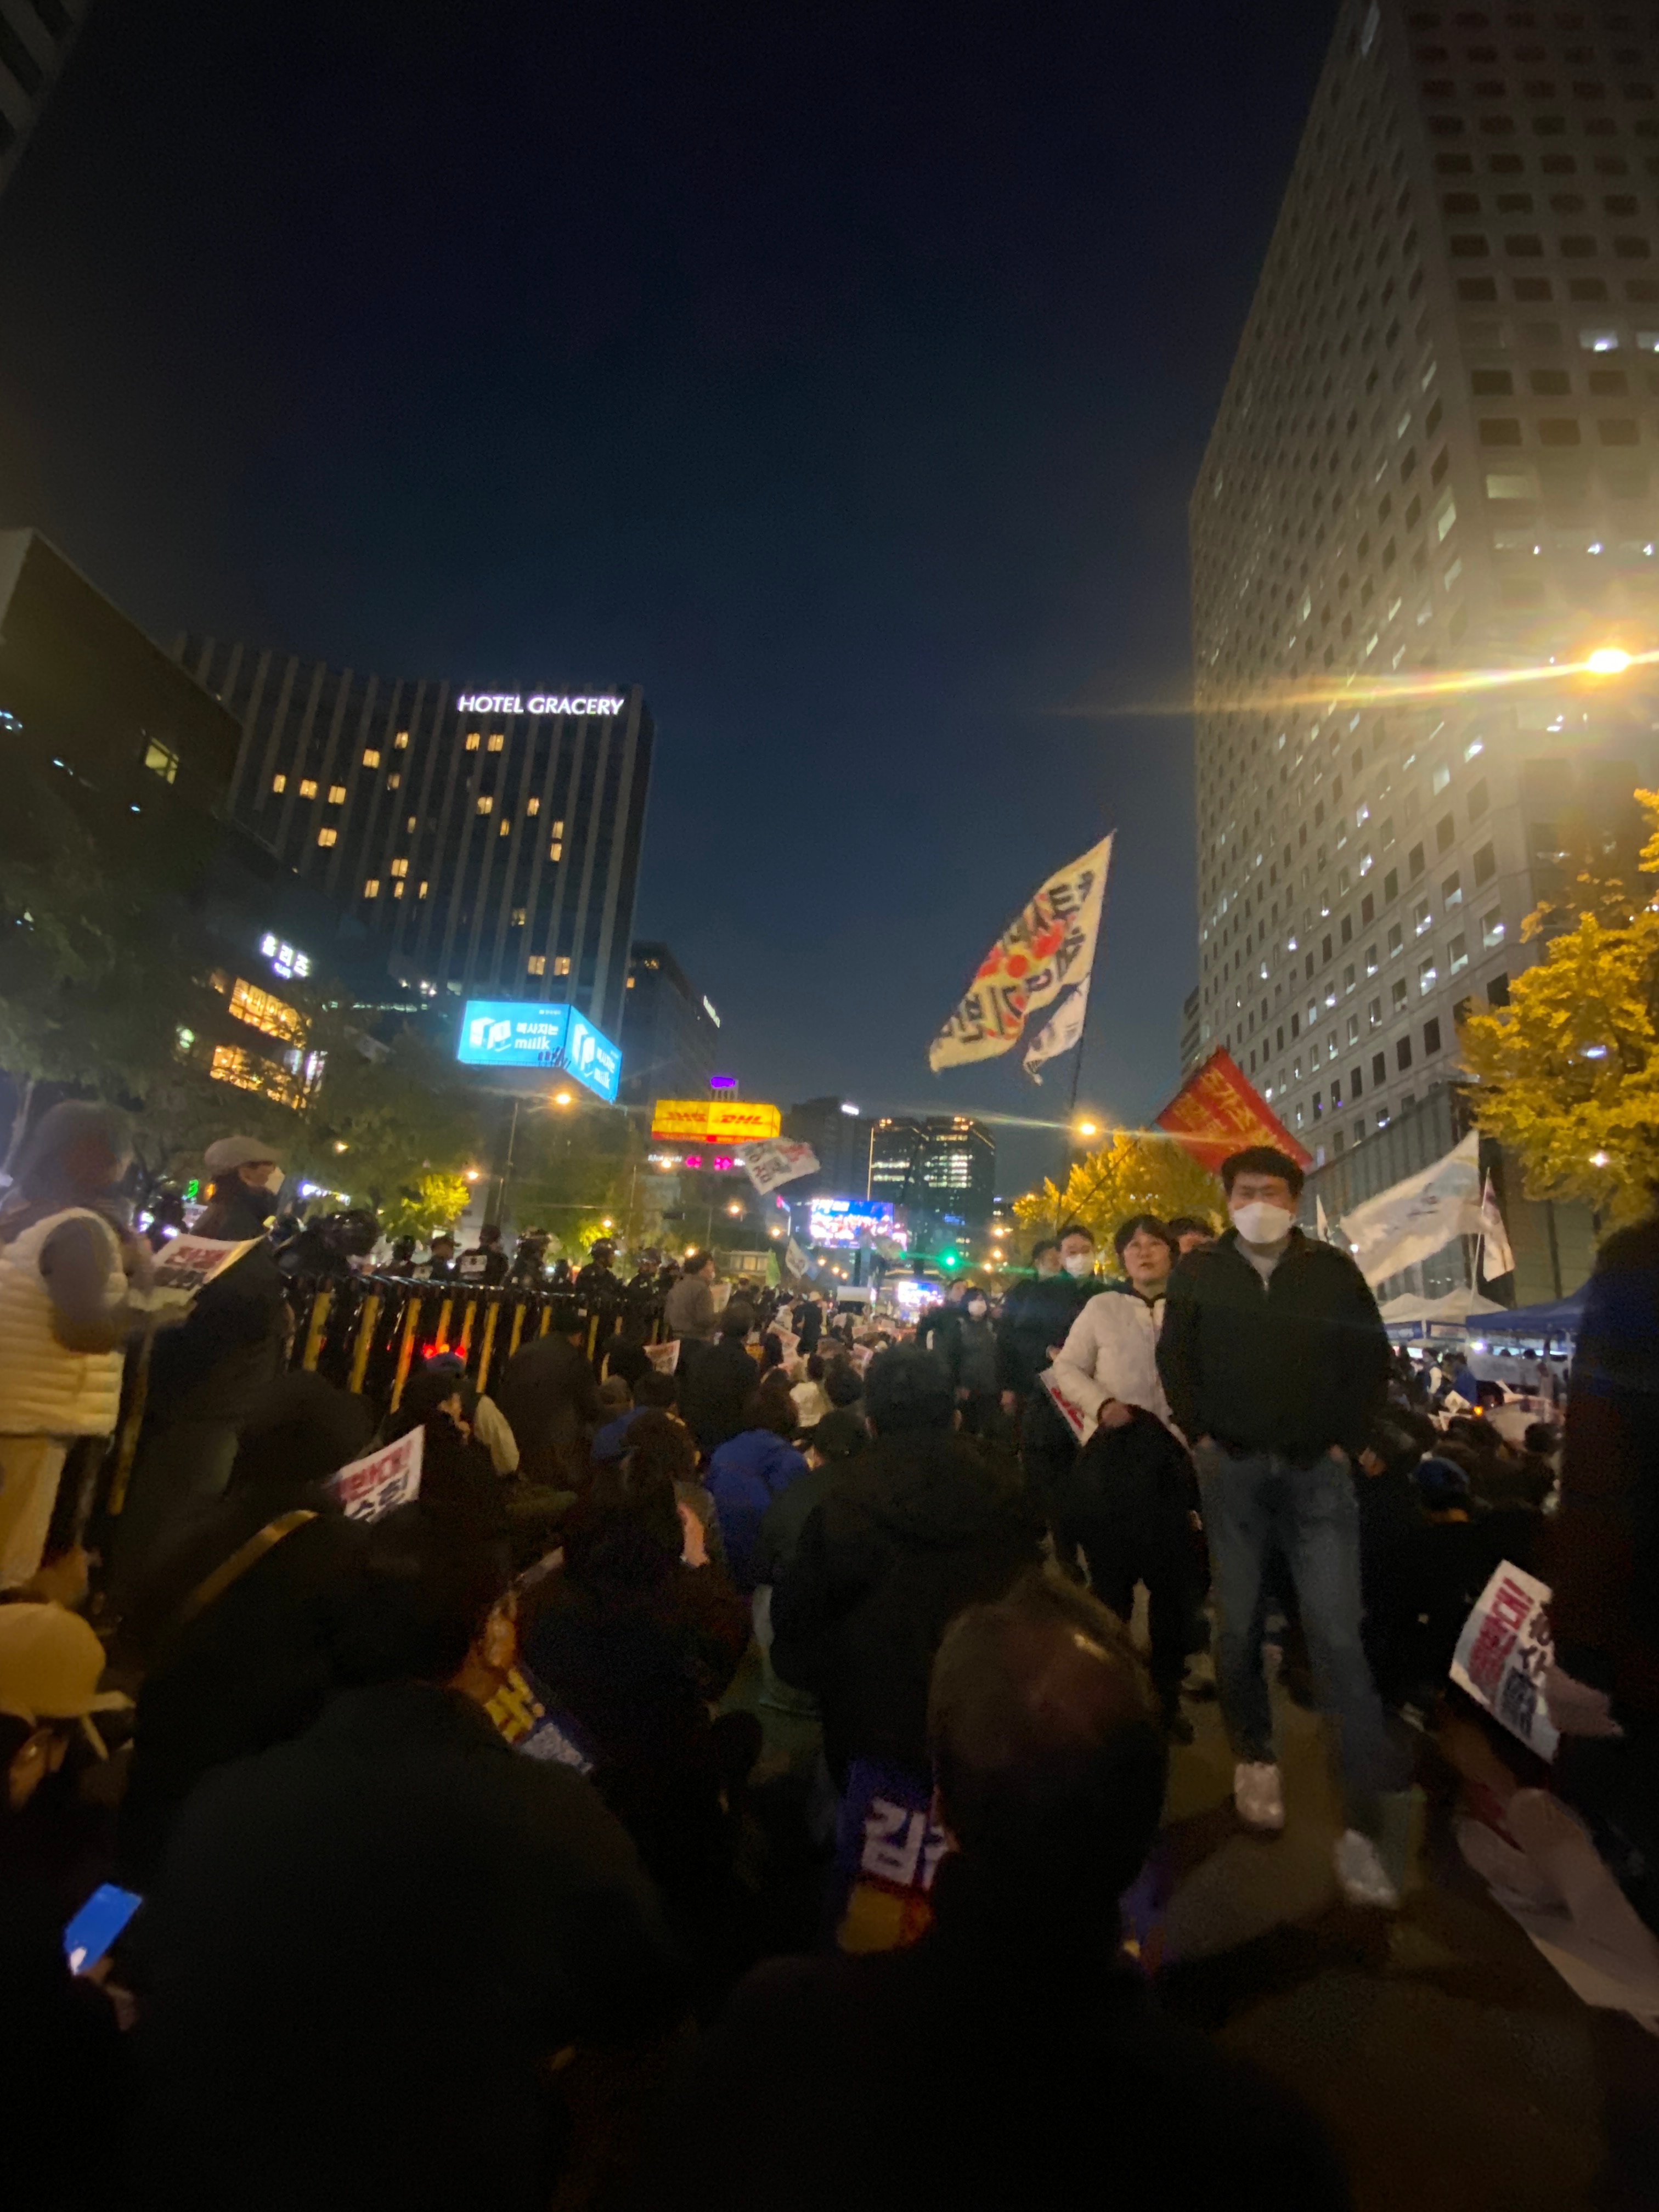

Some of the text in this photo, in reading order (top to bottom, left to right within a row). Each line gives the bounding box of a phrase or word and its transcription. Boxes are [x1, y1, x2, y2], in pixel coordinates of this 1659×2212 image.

[458, 695, 624, 715] HOTEL GRACERY
[720, 1114, 763, 1125] DHL
